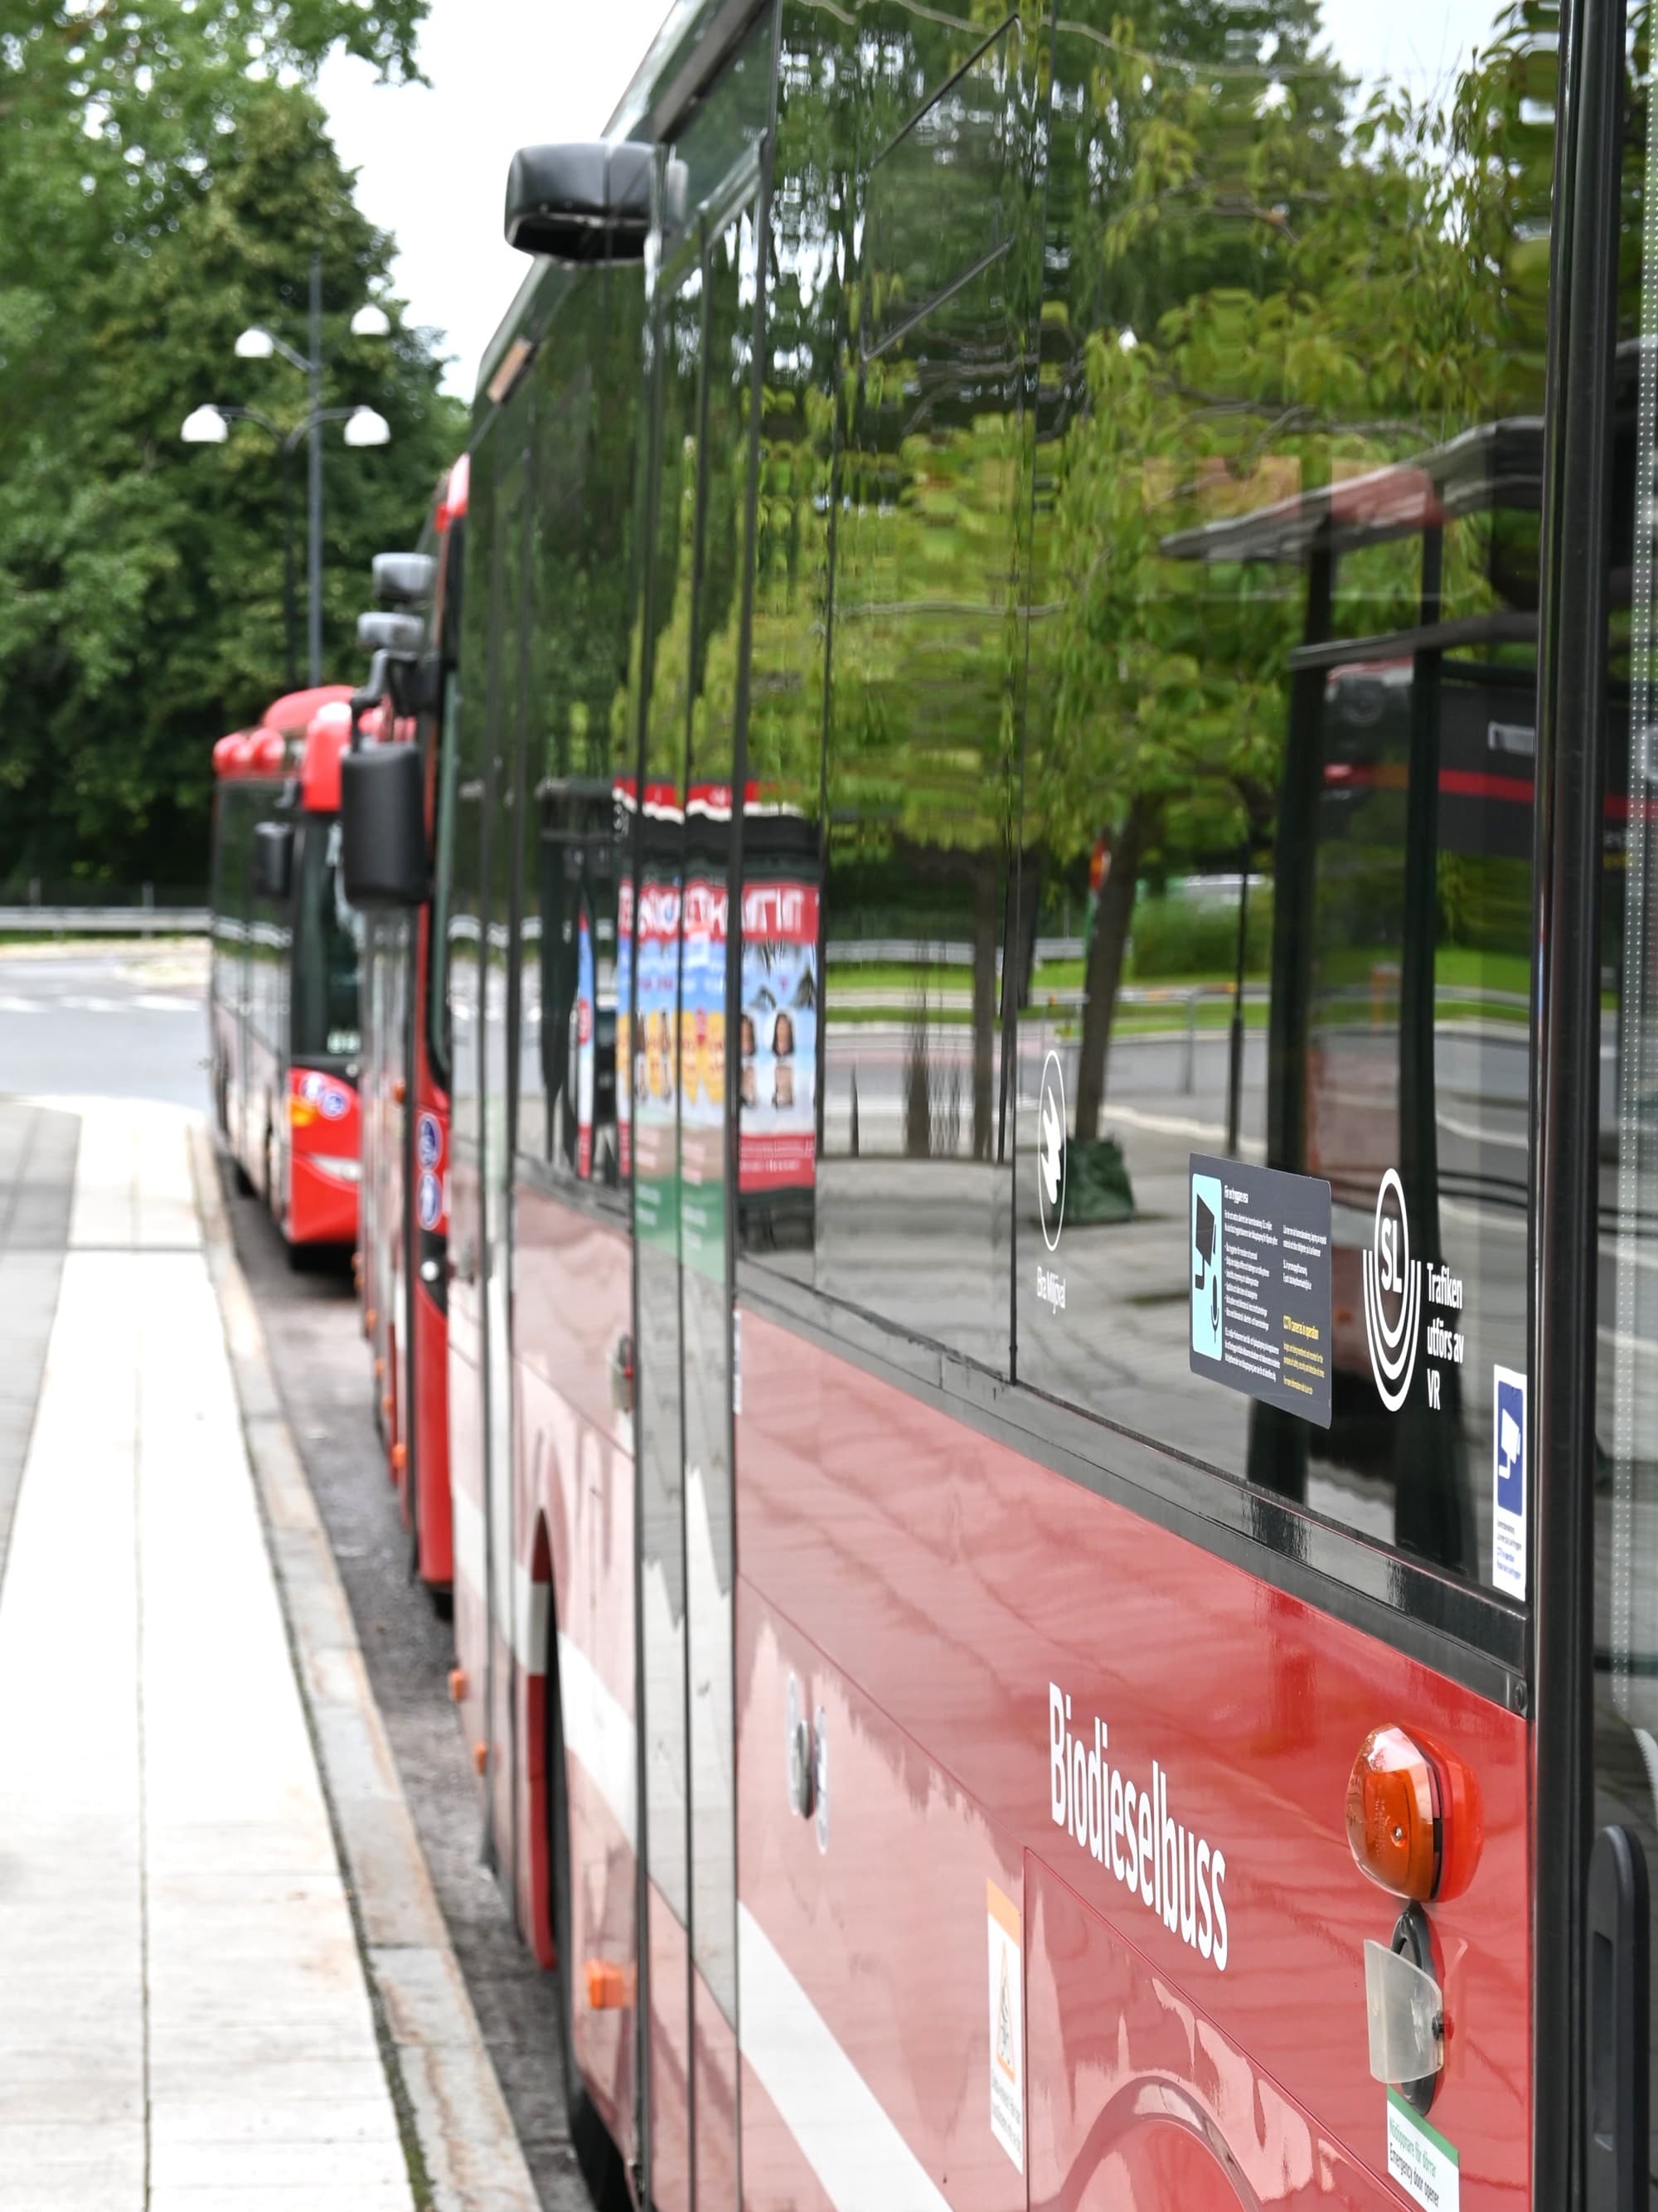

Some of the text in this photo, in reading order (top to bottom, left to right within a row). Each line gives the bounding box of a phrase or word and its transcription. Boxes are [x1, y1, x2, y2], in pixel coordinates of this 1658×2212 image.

[1381, 1218, 1403, 1293] SL
[1427, 1263, 1463, 1309] Trafiken
[1427, 1317, 1464, 1364] utförs av
[1427, 1368, 1441, 1410] VR
[1050, 1681, 1228, 1972] Biodieselbuss
